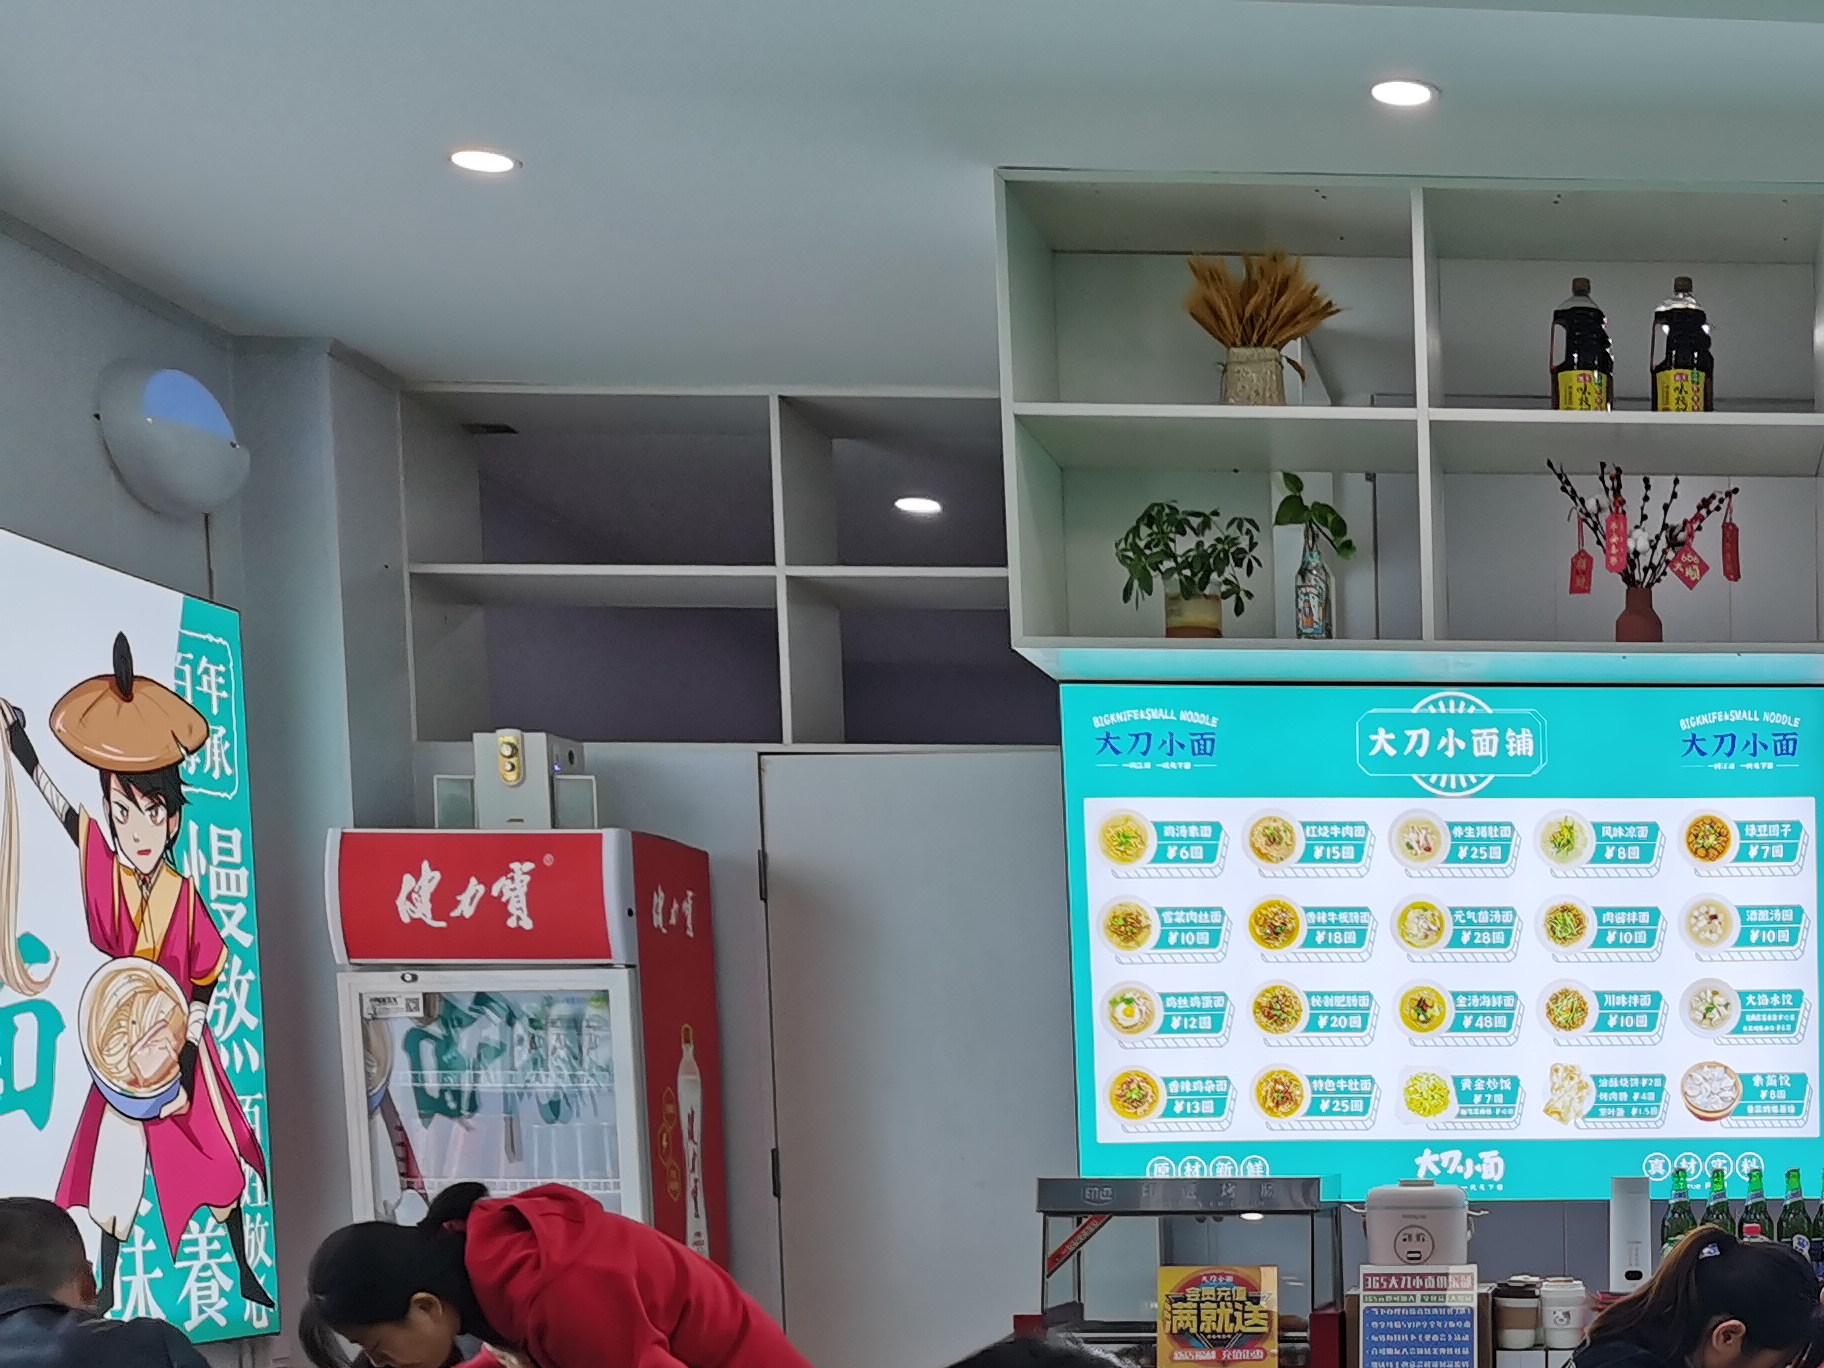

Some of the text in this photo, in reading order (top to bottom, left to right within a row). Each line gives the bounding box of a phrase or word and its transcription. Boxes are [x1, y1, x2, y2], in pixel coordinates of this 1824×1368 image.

[1095, 731, 1217, 757] 大刀小面
[1368, 727, 1535, 758] 大刀小面铺
[1681, 731, 1799, 757] 大刀小面
[1306, 825, 1366, 839] 红烧牛肉面
[1601, 825, 1649, 839] 风味凉面
[1453, 910, 1514, 924] 元气菌汤面
[1602, 911, 1650, 925] 肉酱拌面
[1455, 994, 1515, 1009] 金汤海鲜面
[1604, 994, 1652, 1008] 川味拌面
[1312, 1079, 1372, 1093] 特色牛肚面
[1461, 1078, 1512, 1091] 黄金炒饭
[1163, 1301, 1269, 1334] 满就送
